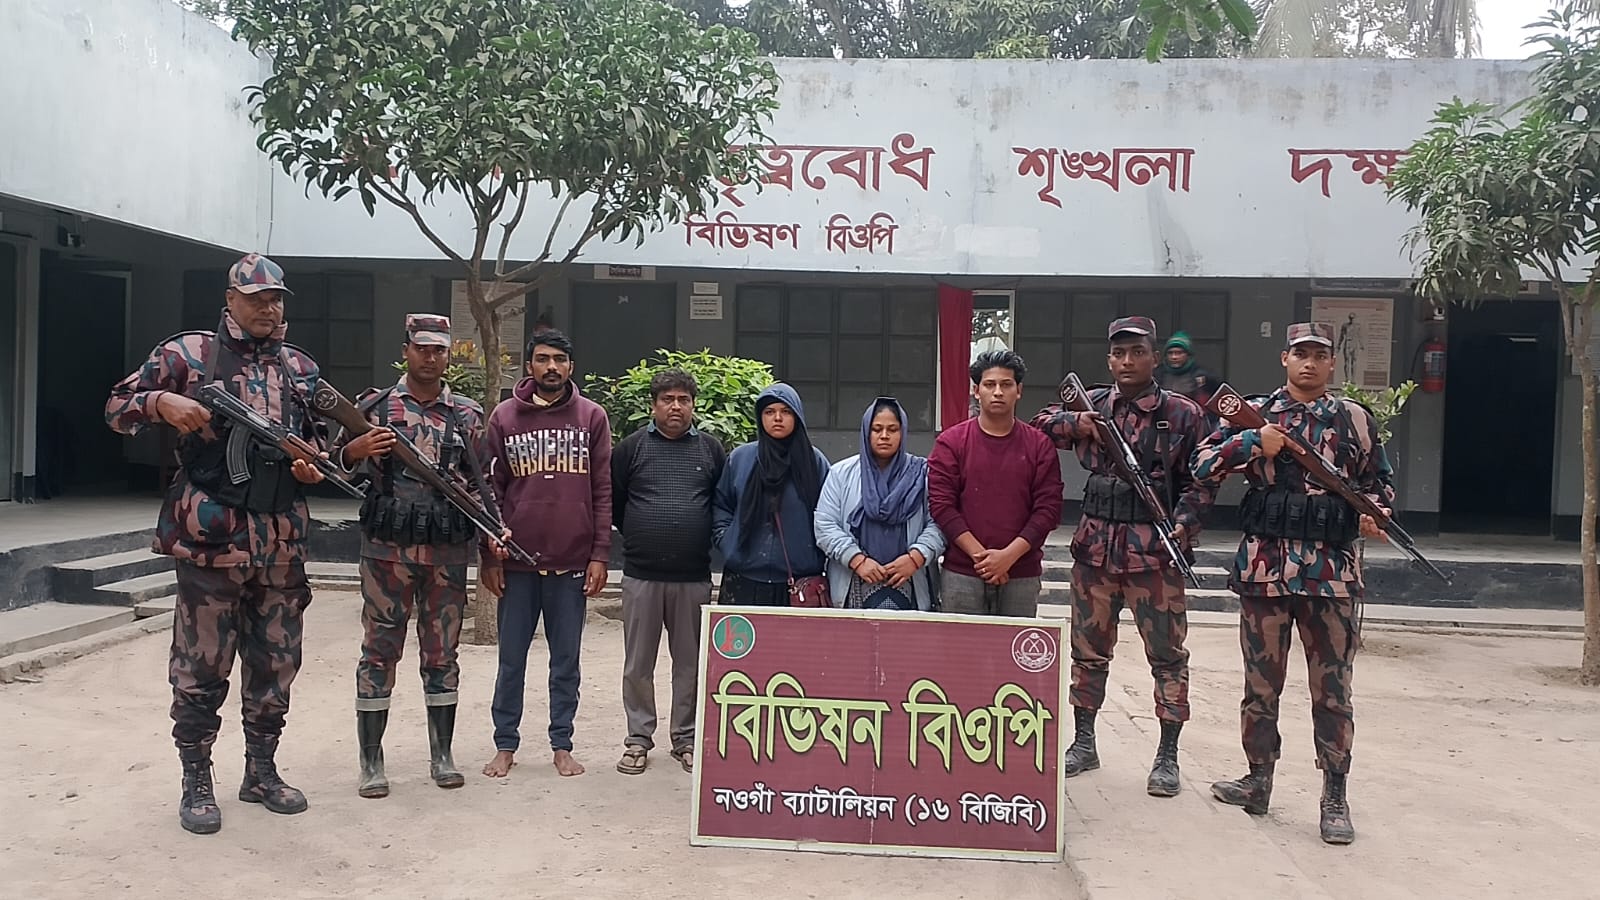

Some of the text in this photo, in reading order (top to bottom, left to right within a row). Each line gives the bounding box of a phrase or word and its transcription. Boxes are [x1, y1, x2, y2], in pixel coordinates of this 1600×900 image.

[1012, 147, 1195, 208] শৃঙ্খলা
[1288, 148, 1412, 198] দক্ষ
[683, 210, 899, 254] বিভিষণ বিওপি
[712, 671, 1053, 773] বিভিষন বিওপি
[713, 782, 1048, 832] নওগাঁ ব্যাটালিয়ন (১৬ বিজিবি)
